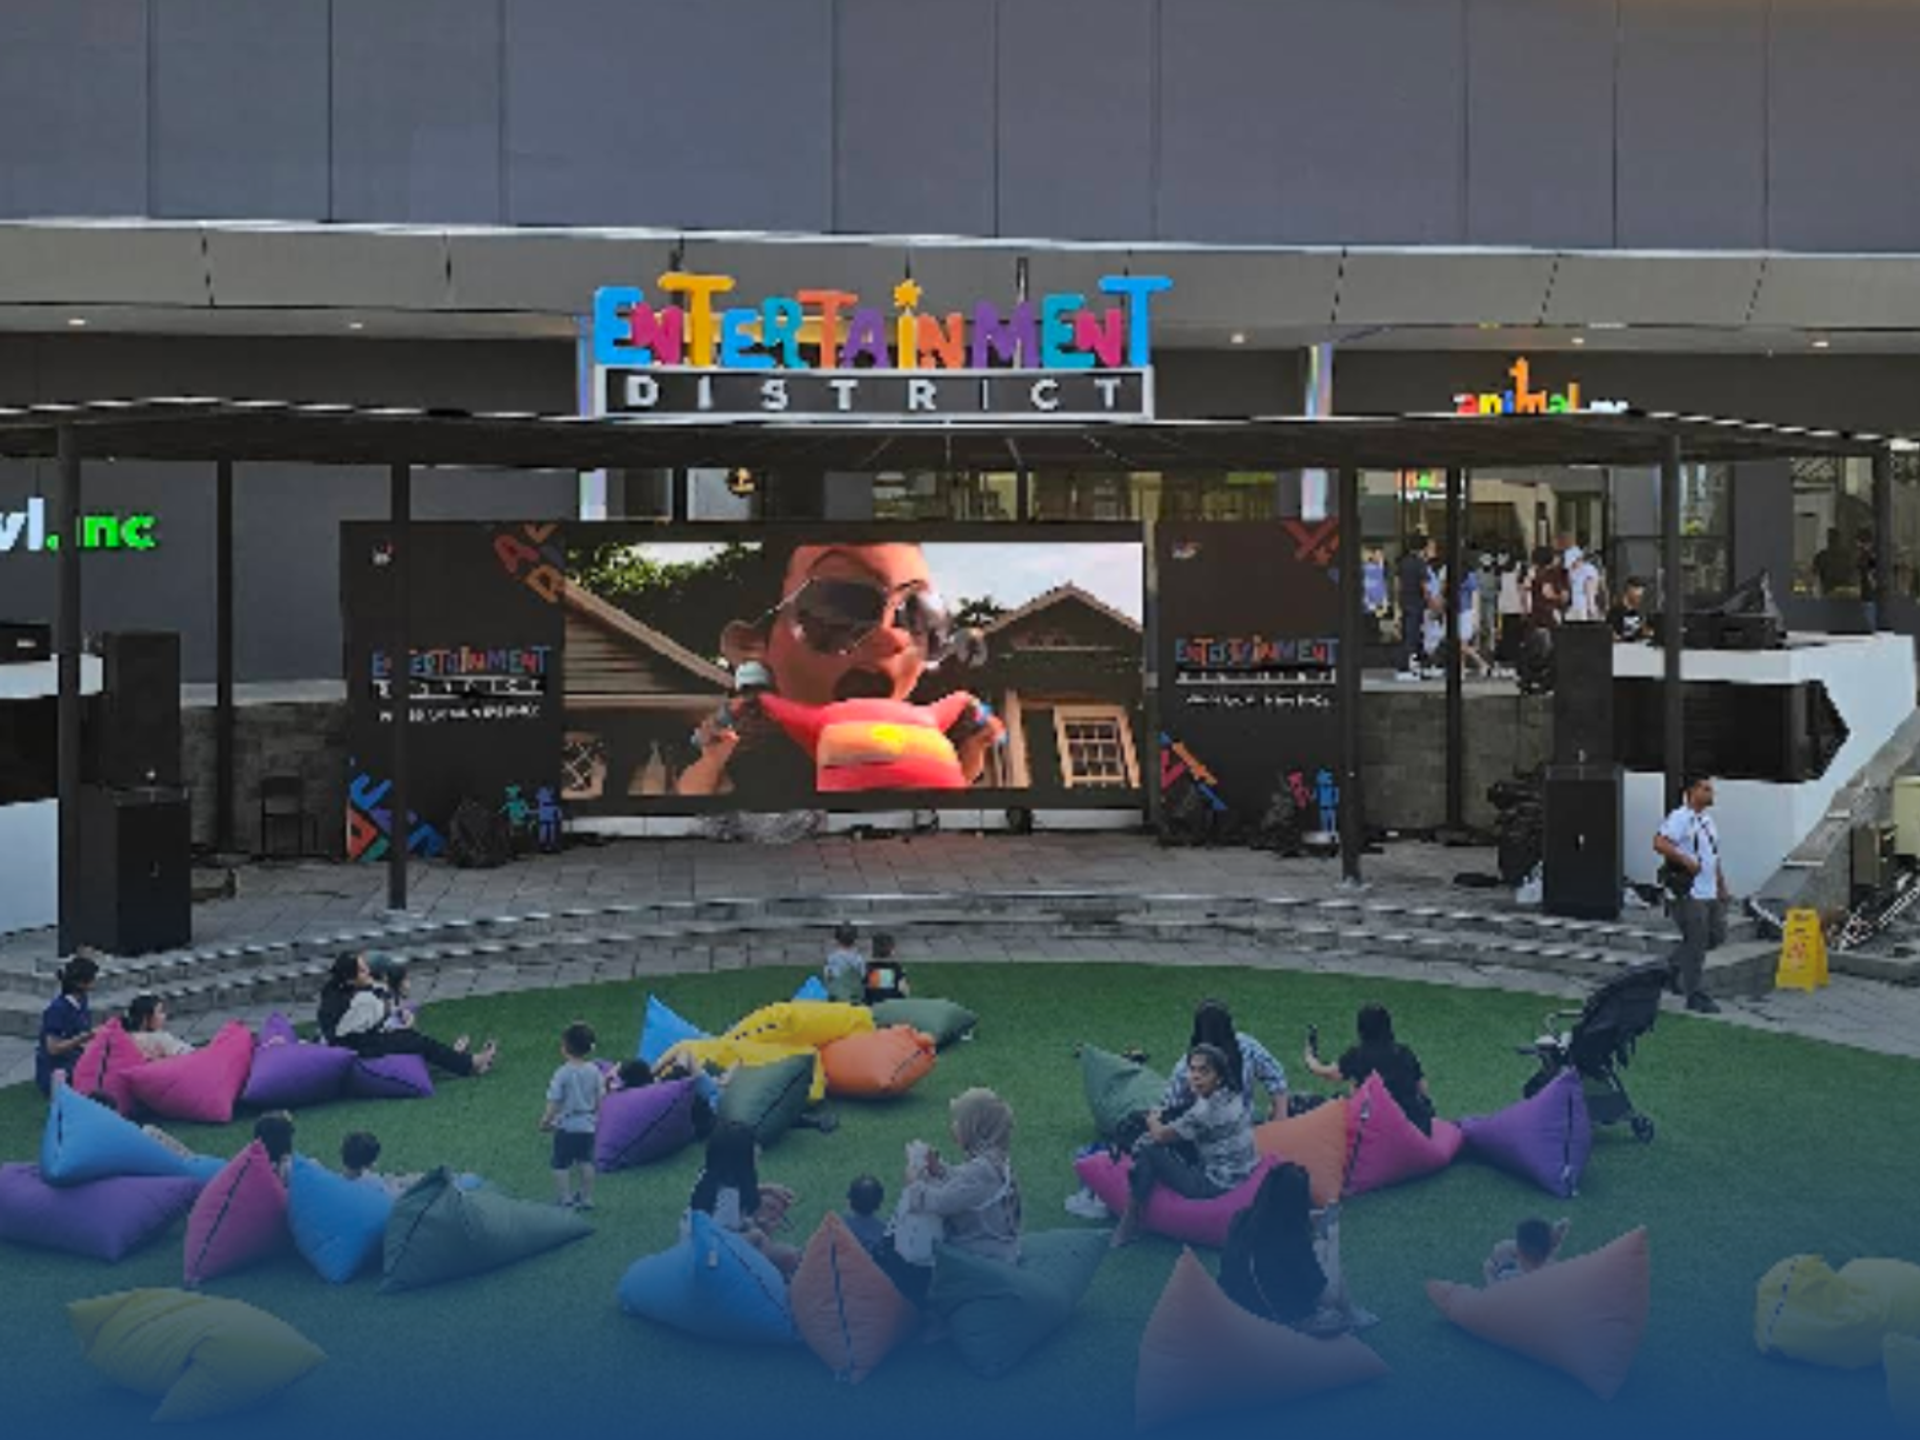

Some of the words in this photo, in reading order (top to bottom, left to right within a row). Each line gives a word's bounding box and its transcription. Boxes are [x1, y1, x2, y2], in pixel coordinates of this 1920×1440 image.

[593, 271, 1173, 369] ENTERTAINMENT
[625, 375, 1122, 411] DISTRICT
[1453, 357, 1580, 414] animal
[0, 497, 156, 551] l.nc
[372, 645, 551, 677] EERTAINMENT
